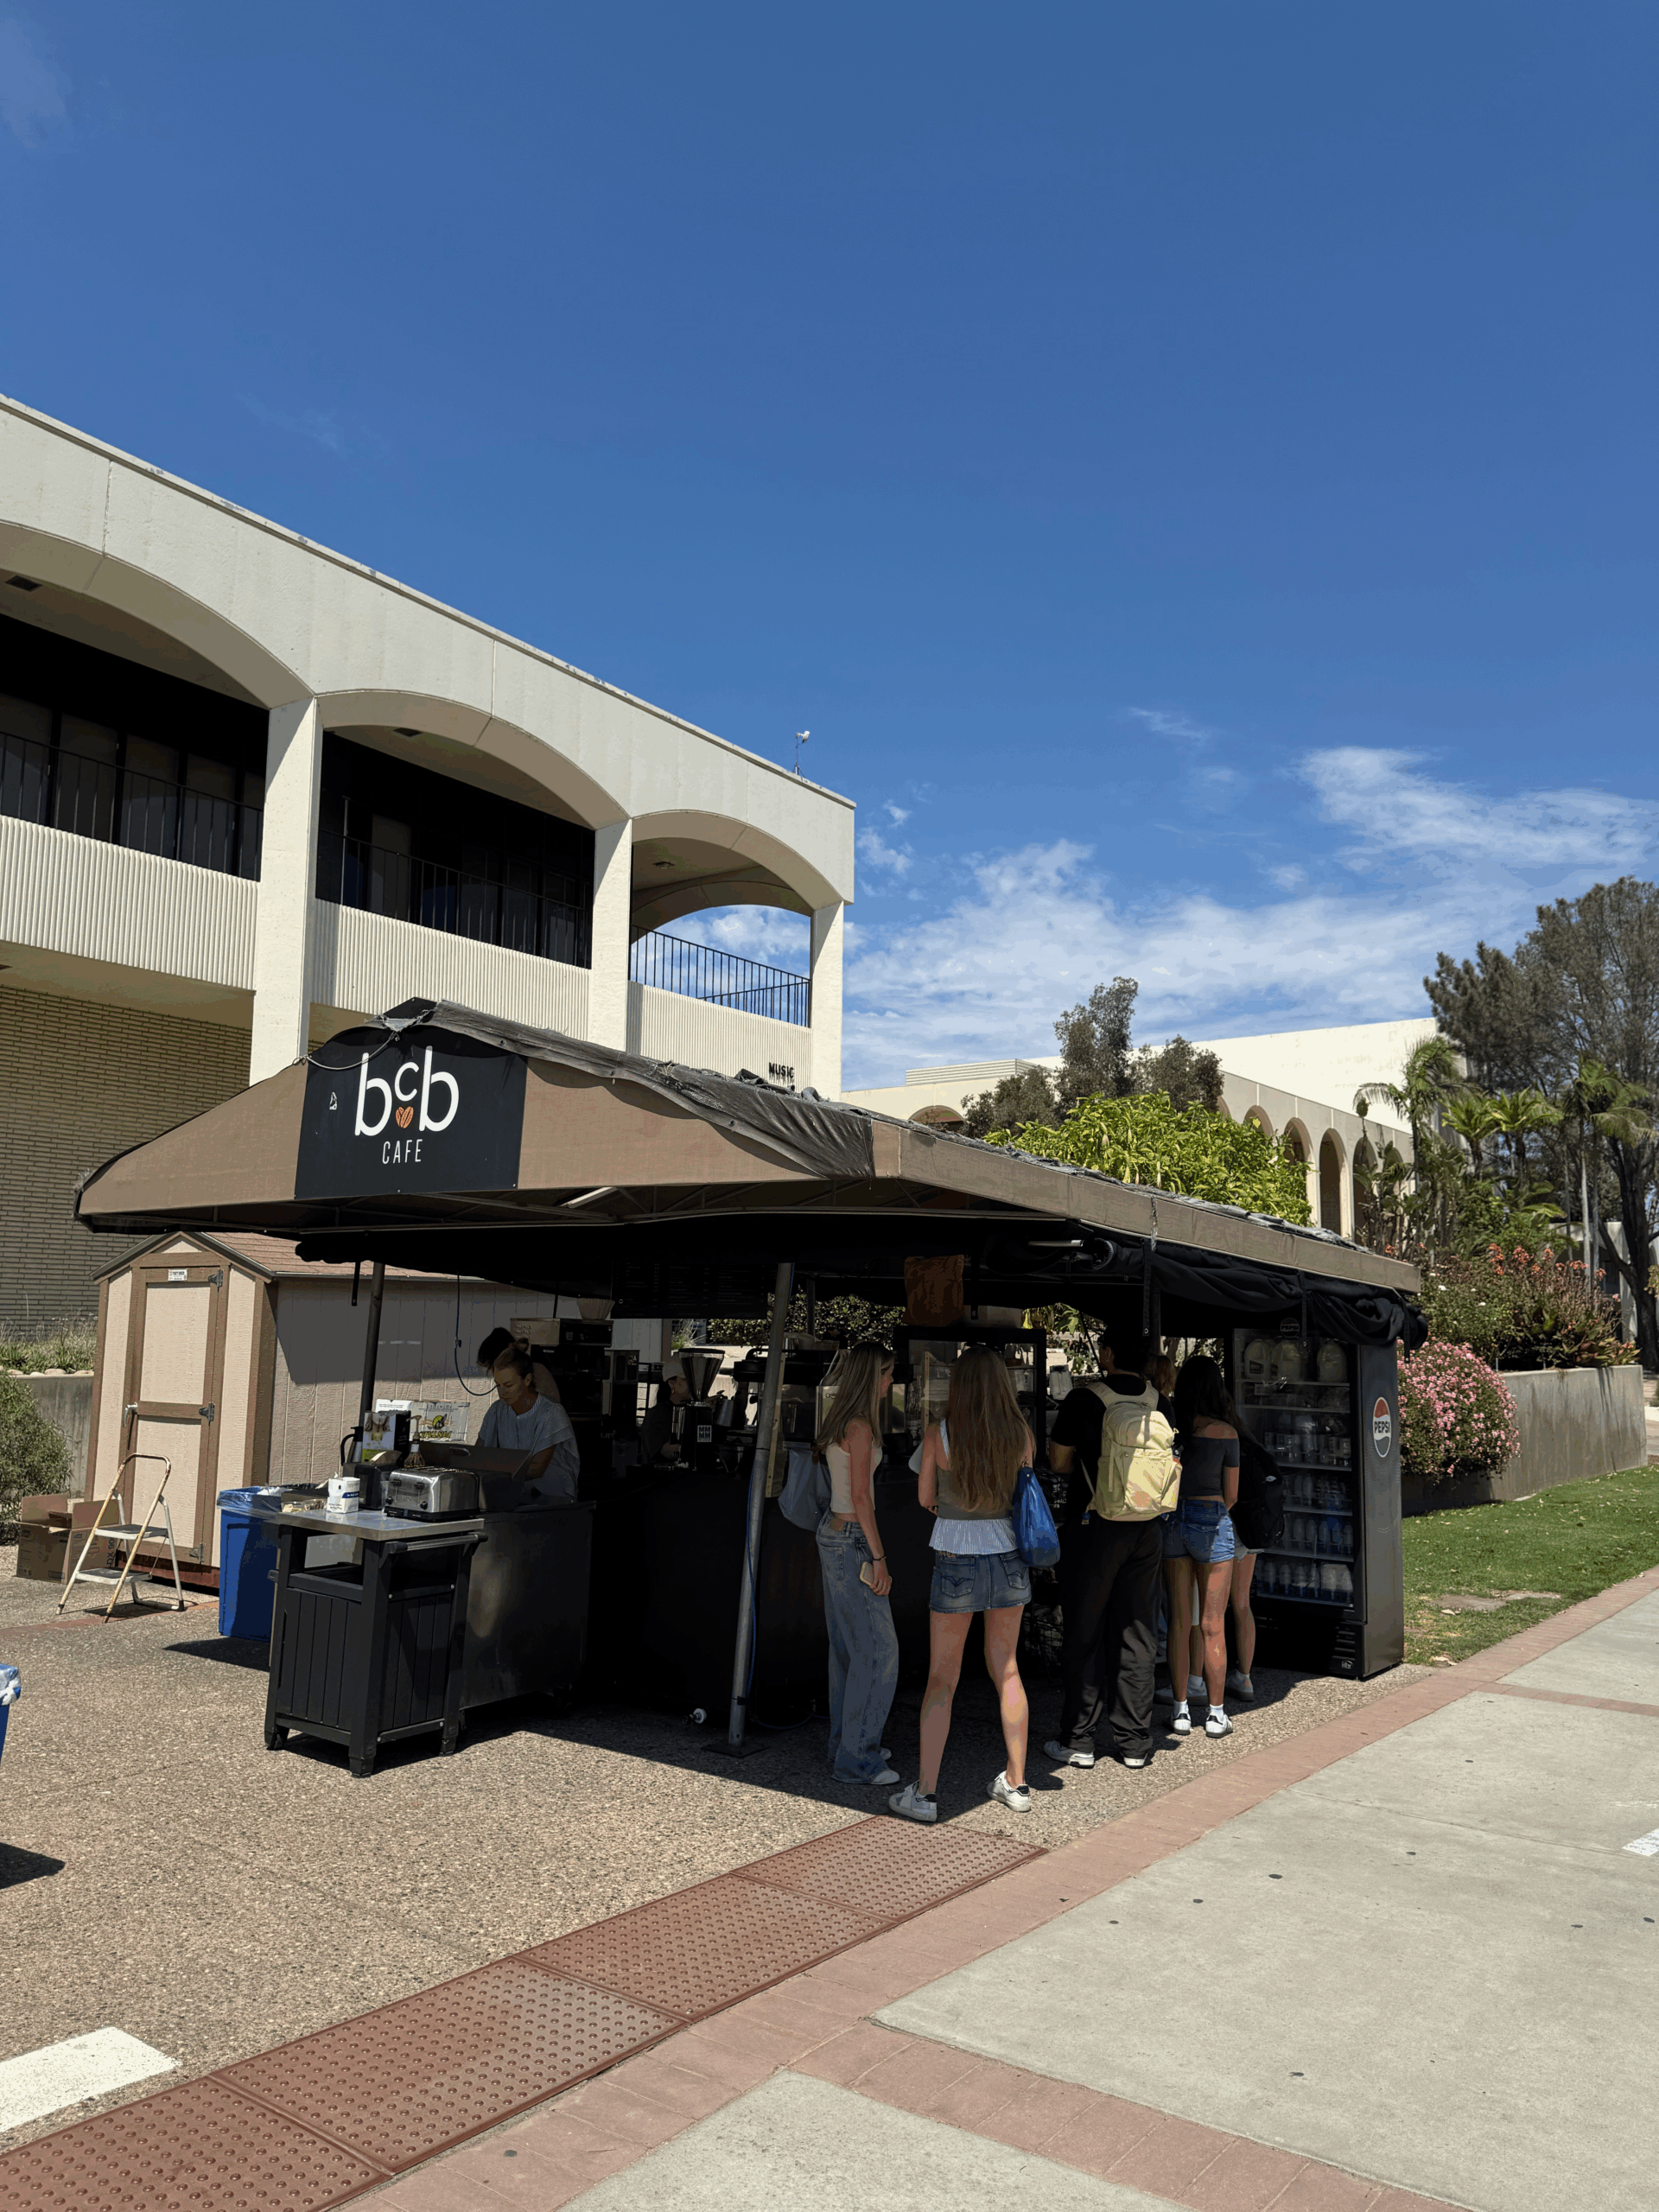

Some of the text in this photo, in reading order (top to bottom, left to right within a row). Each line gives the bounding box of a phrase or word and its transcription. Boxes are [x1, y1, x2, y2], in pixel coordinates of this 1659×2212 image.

[768, 1062, 795, 1078] MUSIC
[355, 1046, 460, 1136] bcb
[382, 1139, 423, 1164] CAFE
[1374, 1421, 1390, 1433] PEPSI
